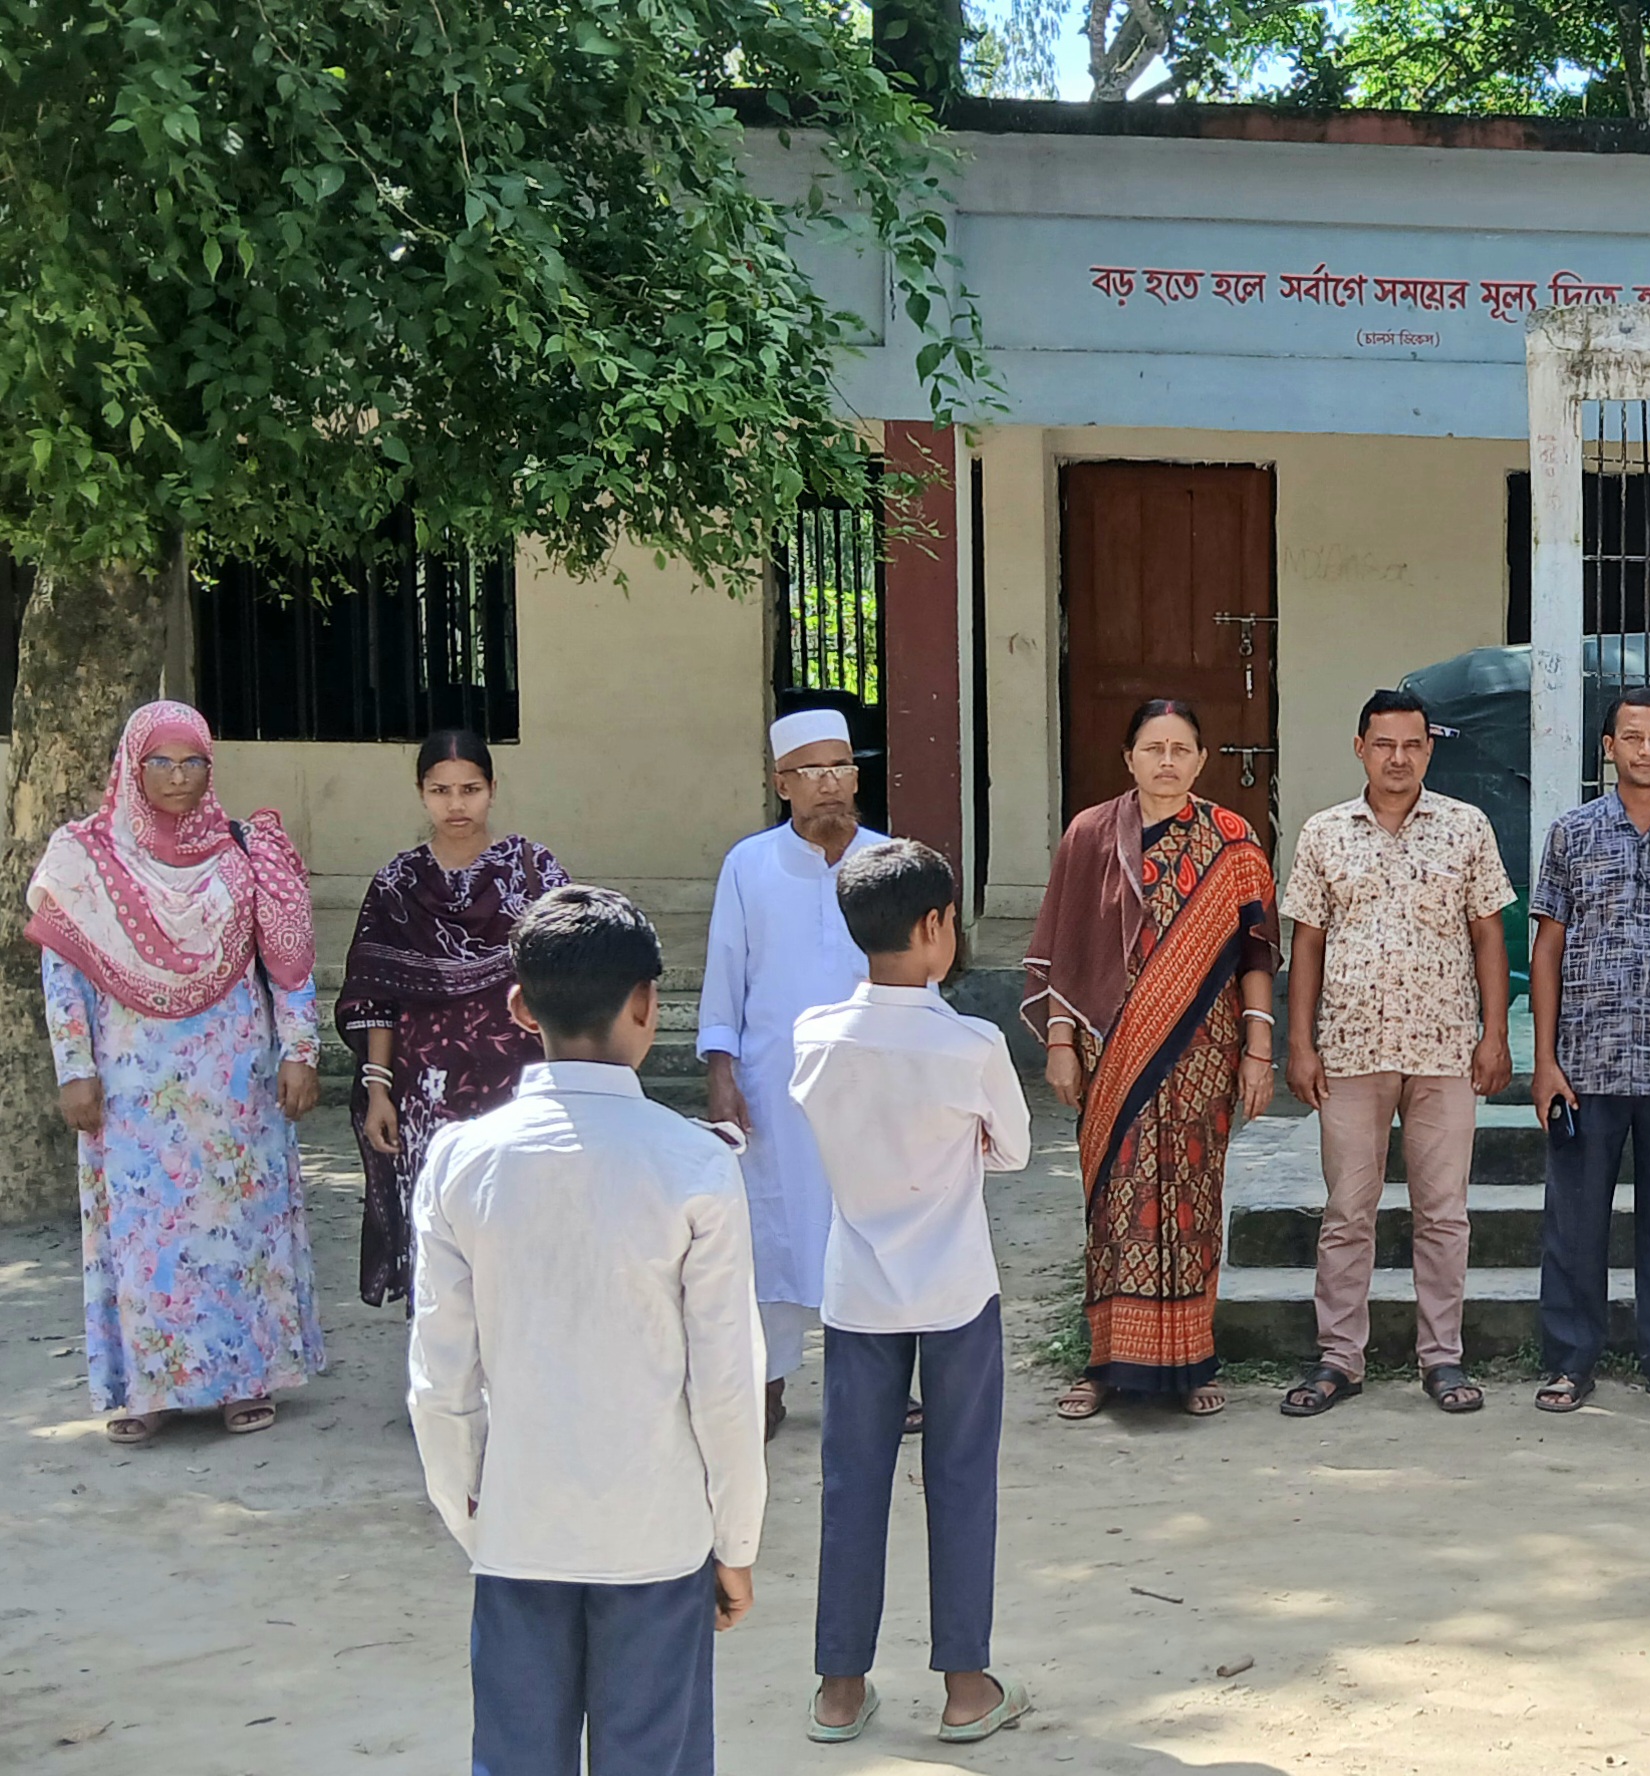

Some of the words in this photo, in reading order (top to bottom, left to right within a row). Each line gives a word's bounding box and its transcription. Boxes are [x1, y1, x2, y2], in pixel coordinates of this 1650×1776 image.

[1090, 265, 1137, 307] বড়
[1142, 268, 1206, 307] হতে
[1210, 271, 1267, 307] হলে
[1373, 276, 1471, 311] সময়ের
[1479, 280, 1538, 324] মূল্য
